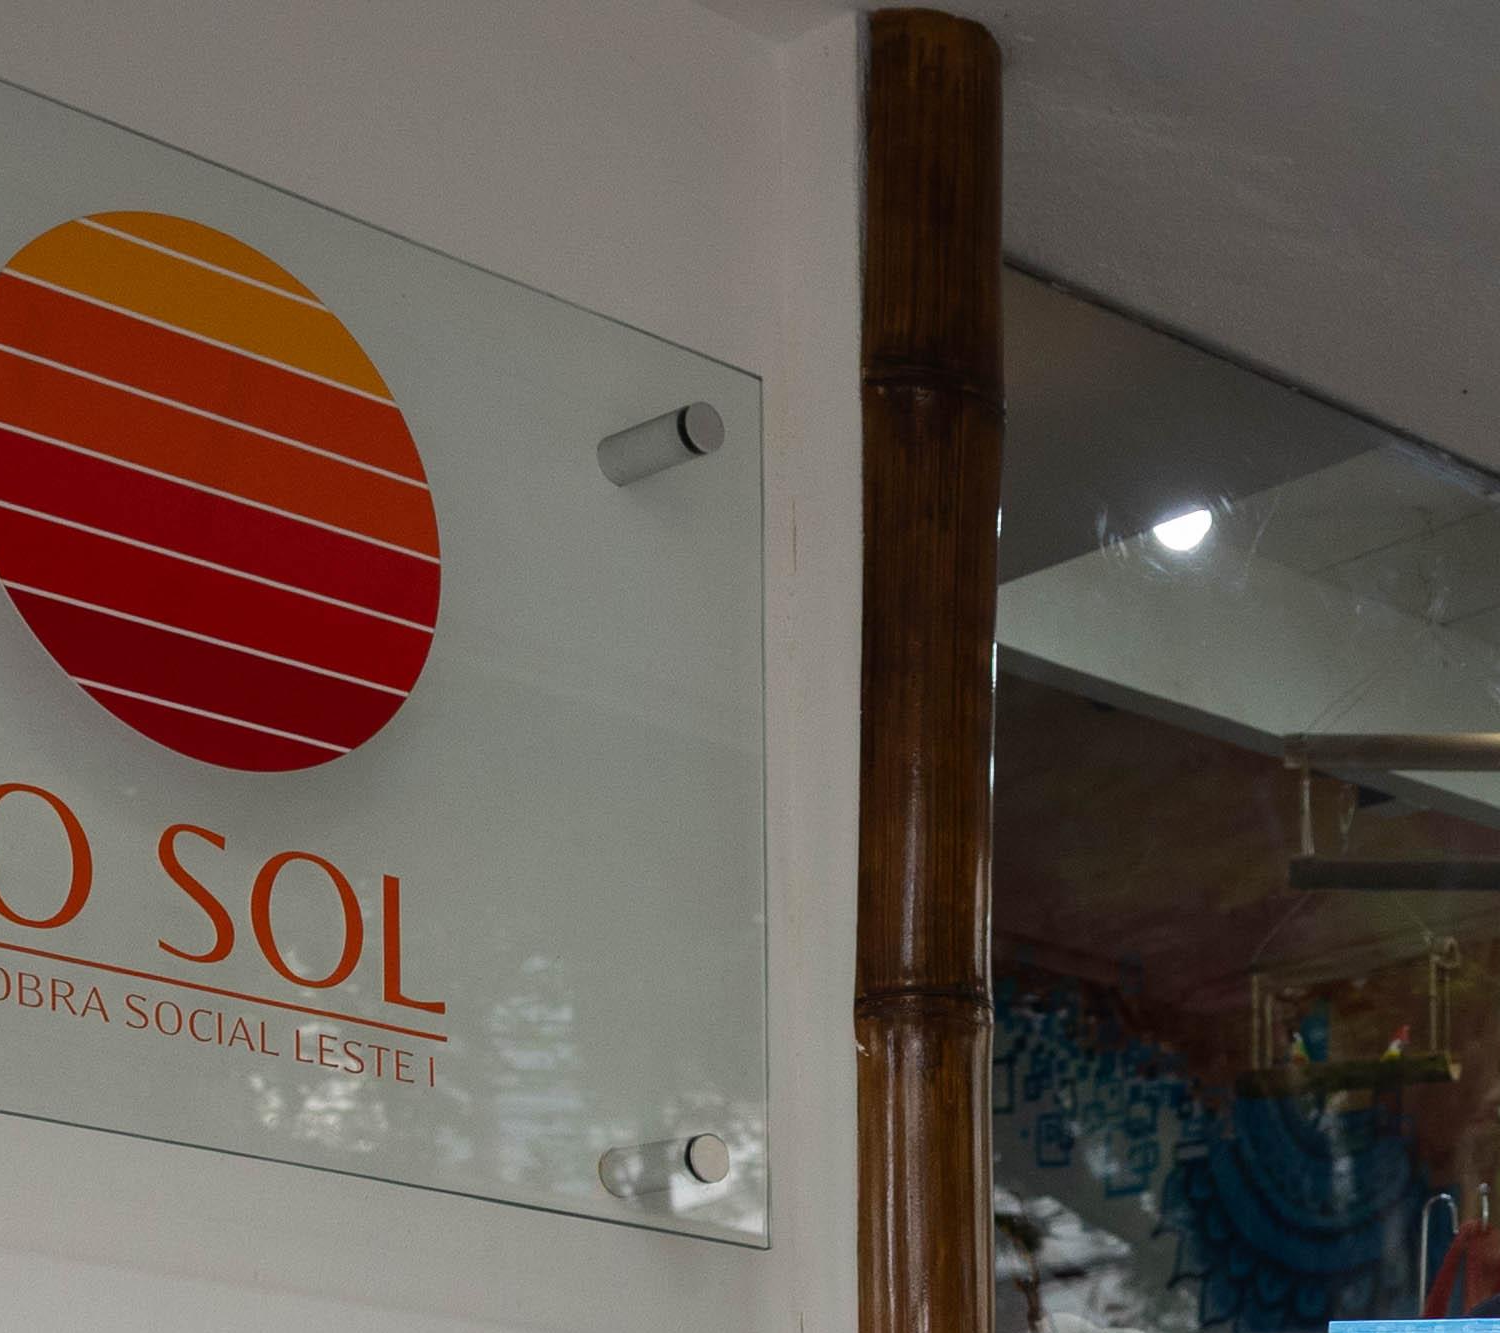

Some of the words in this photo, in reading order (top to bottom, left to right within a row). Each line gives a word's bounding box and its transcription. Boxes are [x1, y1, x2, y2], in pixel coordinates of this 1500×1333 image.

[158, 823, 446, 1015] SOL
[125, 994, 280, 1057] SOCIAL
[295, 1029, 415, 1085] LESTE
